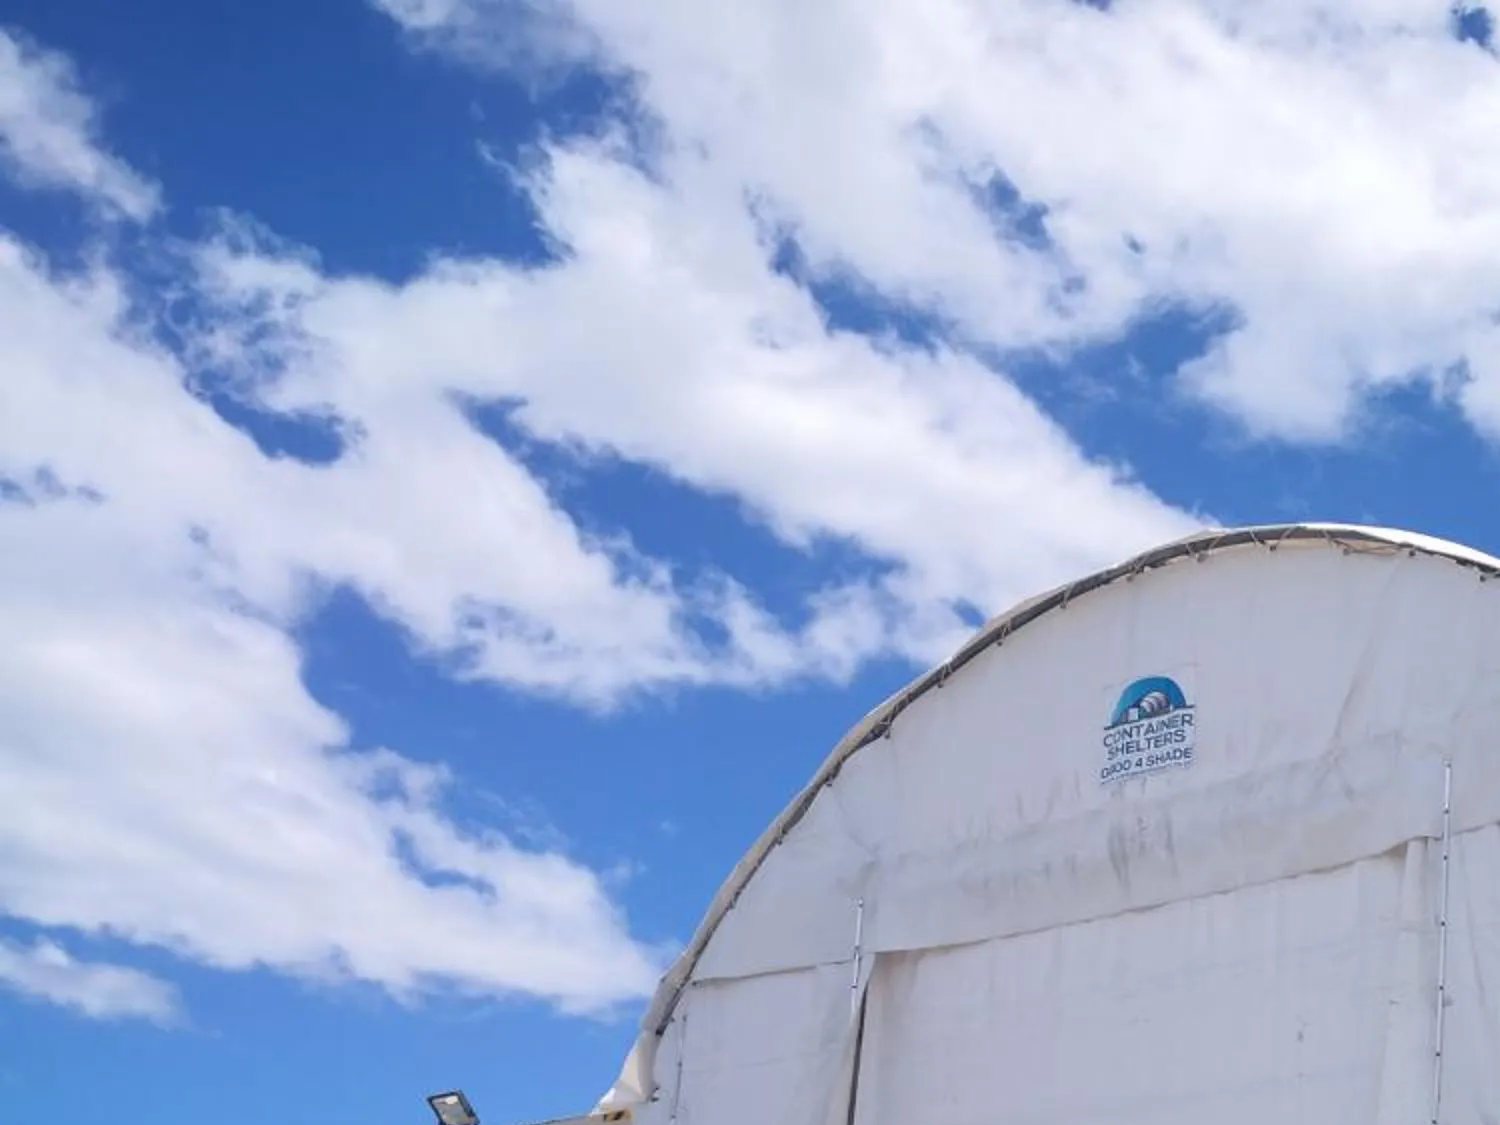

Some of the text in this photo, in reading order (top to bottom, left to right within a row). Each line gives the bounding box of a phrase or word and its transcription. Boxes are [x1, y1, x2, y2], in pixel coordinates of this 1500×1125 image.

[1103, 713, 1194, 748] CONTAINER
[1107, 729, 1187, 761] SHELTERS
[1145, 746, 1193, 767] SHADE
